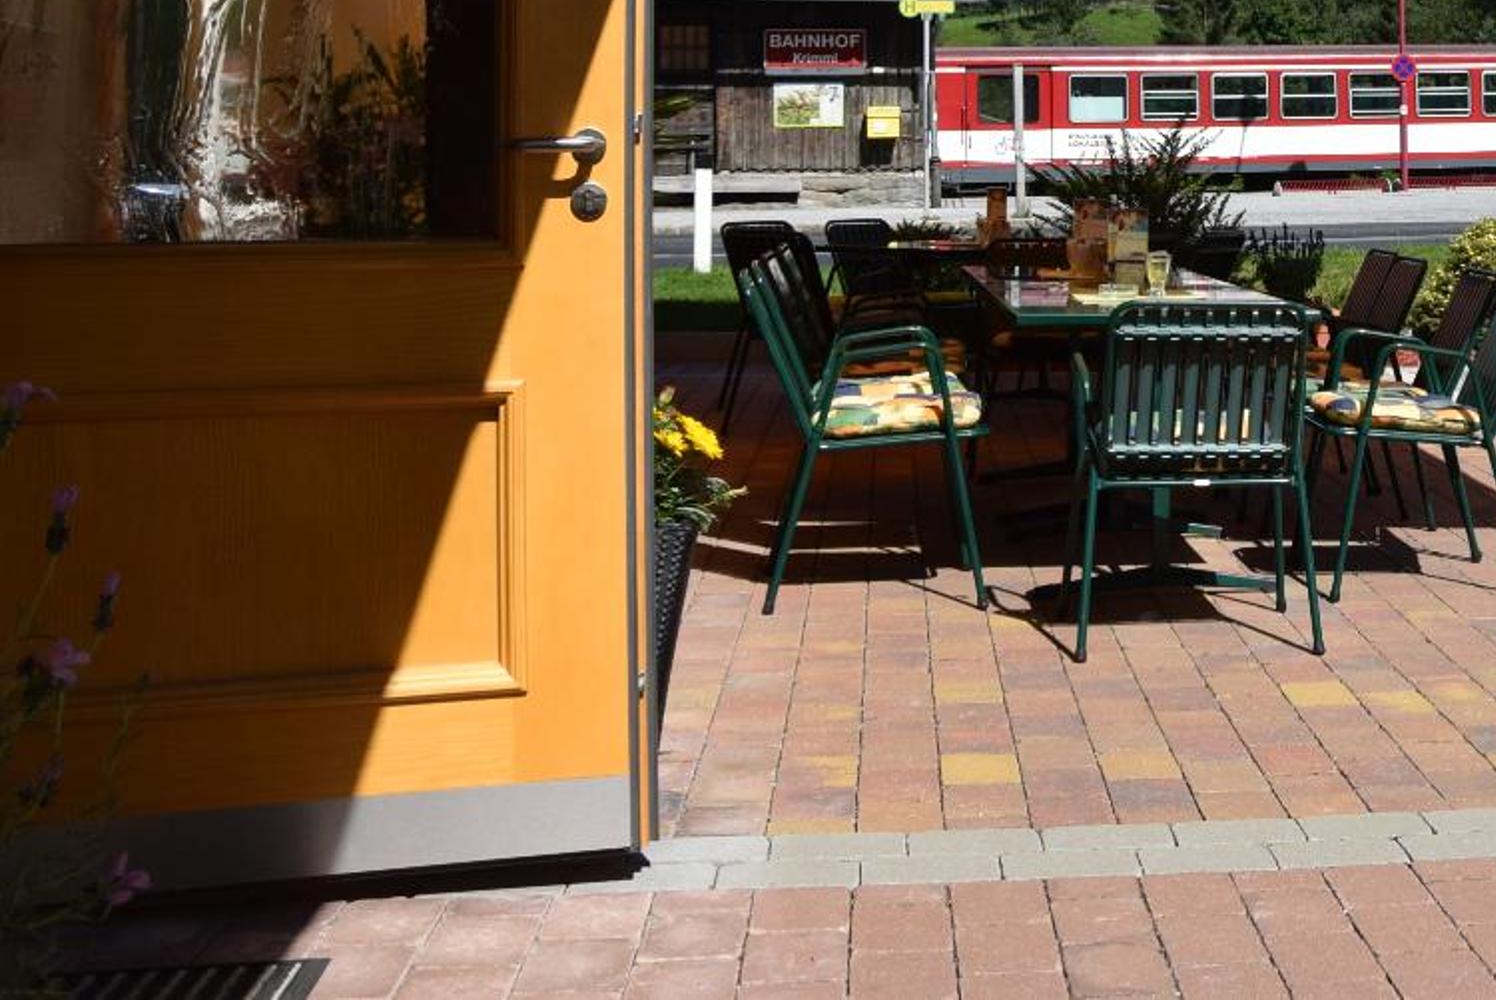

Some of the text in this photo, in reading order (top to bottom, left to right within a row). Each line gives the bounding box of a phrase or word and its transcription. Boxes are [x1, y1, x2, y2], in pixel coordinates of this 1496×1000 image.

[904, 0, 916, 14] H
[769, 33, 861, 49] BAHNHOF
[793, 52, 838, 64] Krimml
